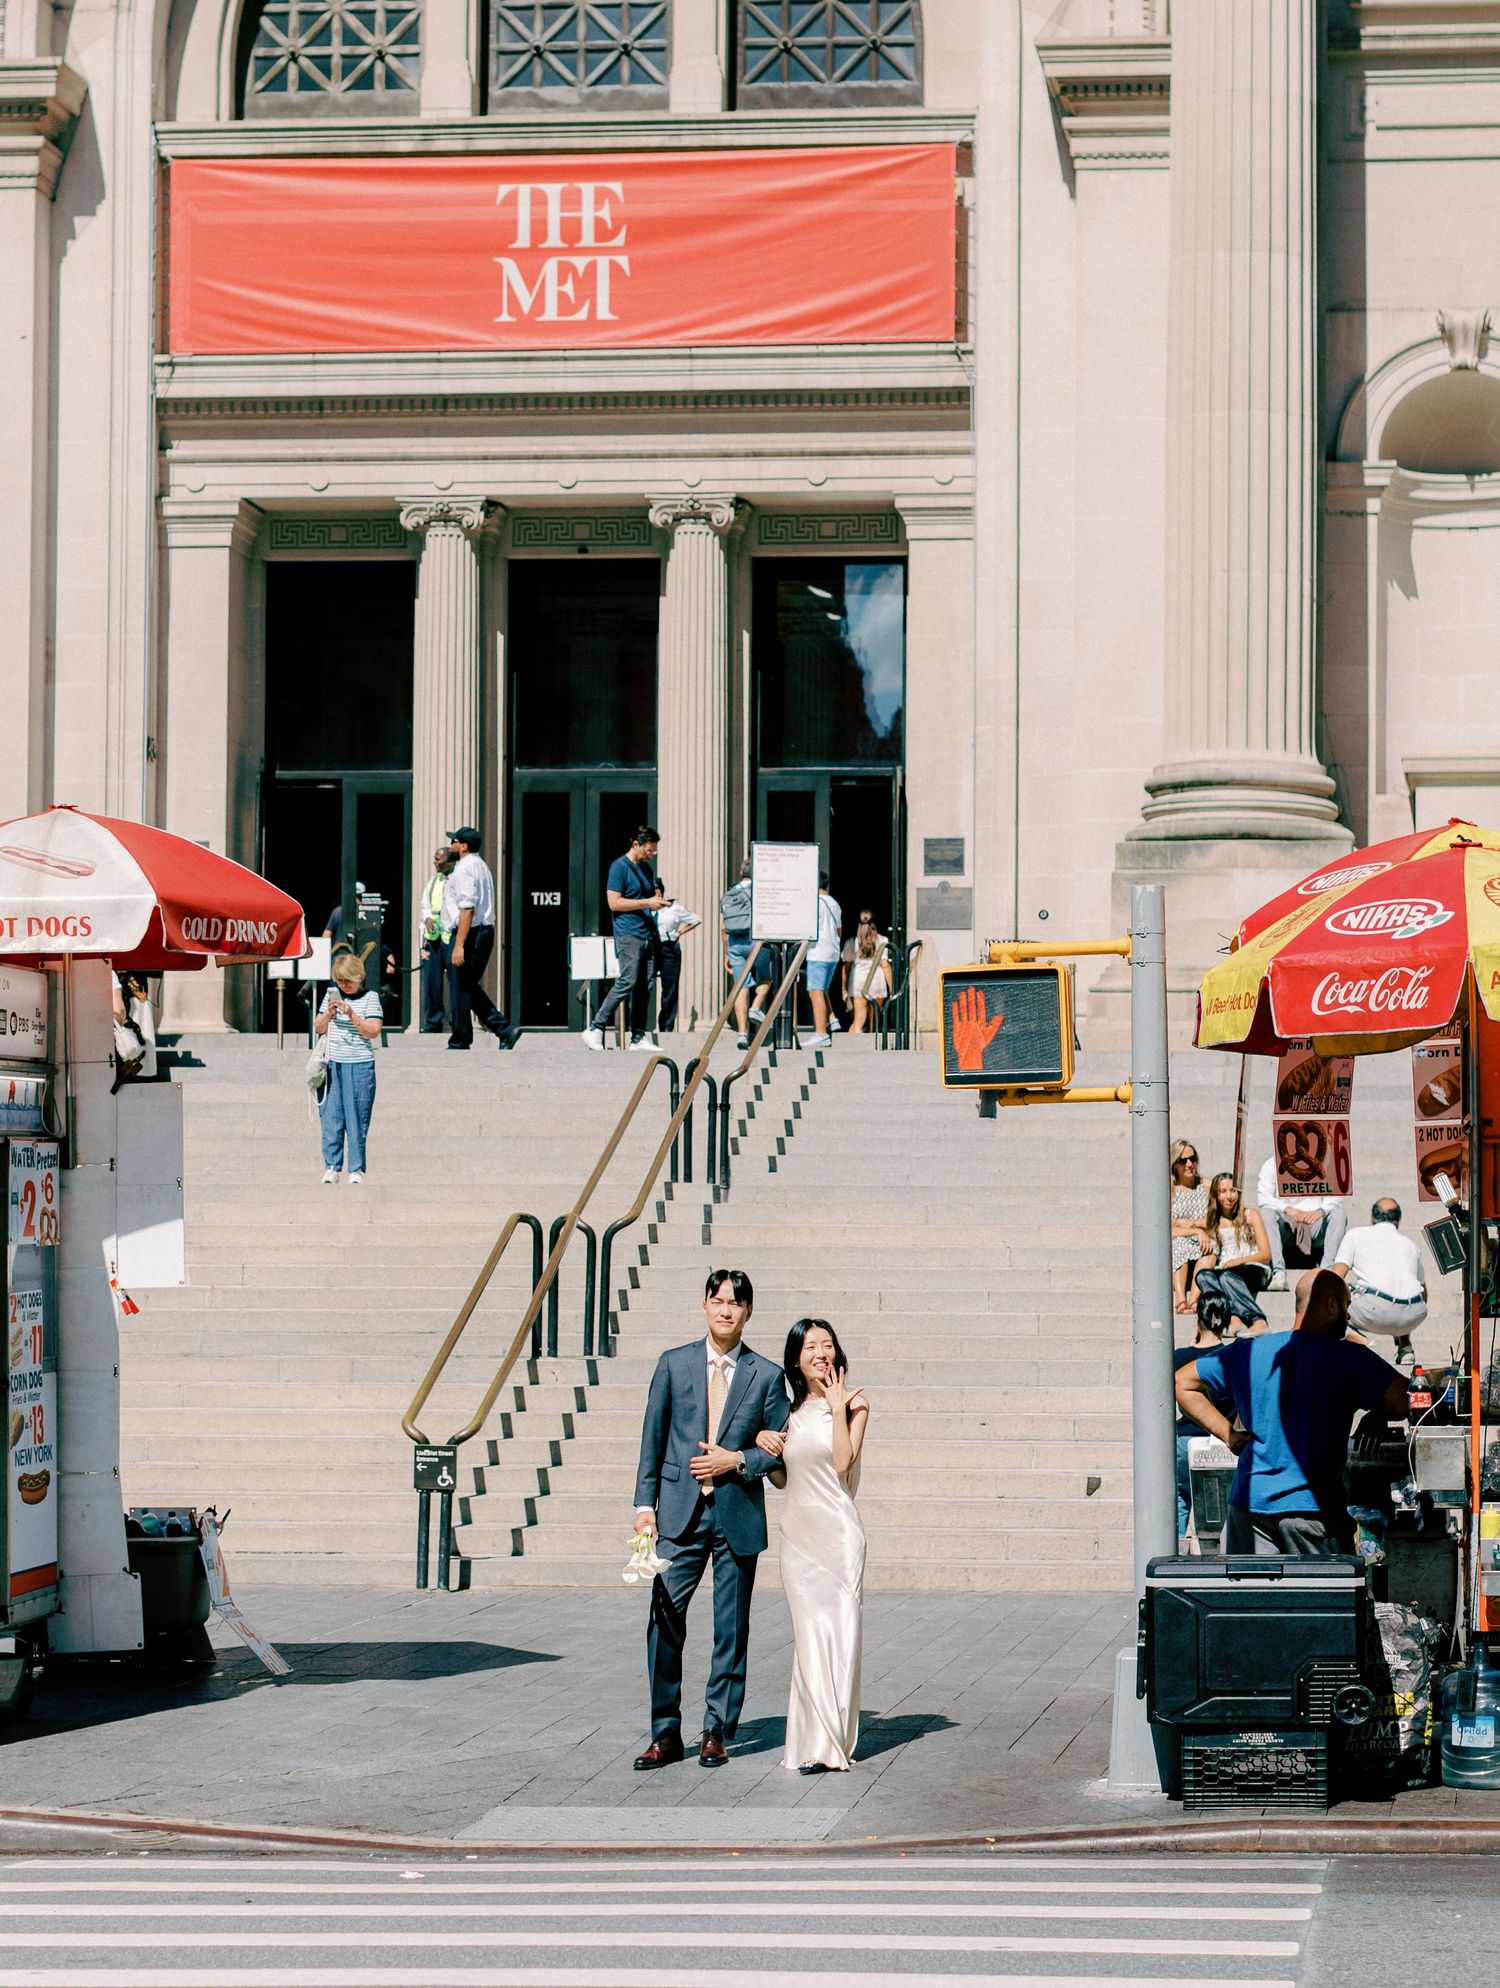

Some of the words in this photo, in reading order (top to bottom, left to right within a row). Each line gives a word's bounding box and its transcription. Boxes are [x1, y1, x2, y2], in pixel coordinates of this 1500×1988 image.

[496, 182, 627, 248] THE
[492, 255, 631, 322] MET
[27, 916, 92, 938] DOGS
[1343, 904, 1428, 929] NIKAS
[181, 917, 223, 941] COLD
[225, 919, 278, 944] DRINKS
[1311, 966, 1435, 1016] Coca-Cola
[1287, 1040, 1303, 1050] orn
[1418, 1129, 1424, 1142] 2
[1426, 1128, 1445, 1142] HOT
[36, 1147, 58, 1171] Pretzel
[1282, 1183, 1332, 1194] PRETZEL
[10, 1293, 17, 1324] 2
[17, 1294, 28, 1310] HOT
[28, 1291, 42, 1309] DOGS
[10, 1373, 28, 1393] CORN
[28, 1370, 43, 1390] DOG
[29, 1403, 44, 1445] $13
[15, 1449, 32, 1467] NEW
[34, 1444, 53, 1464] YORK
[1375, 1691, 1415, 1705] XTRA
[1375, 1704, 1414, 1717] ARGE
[1346, 1721, 1409, 1743] LUMP
